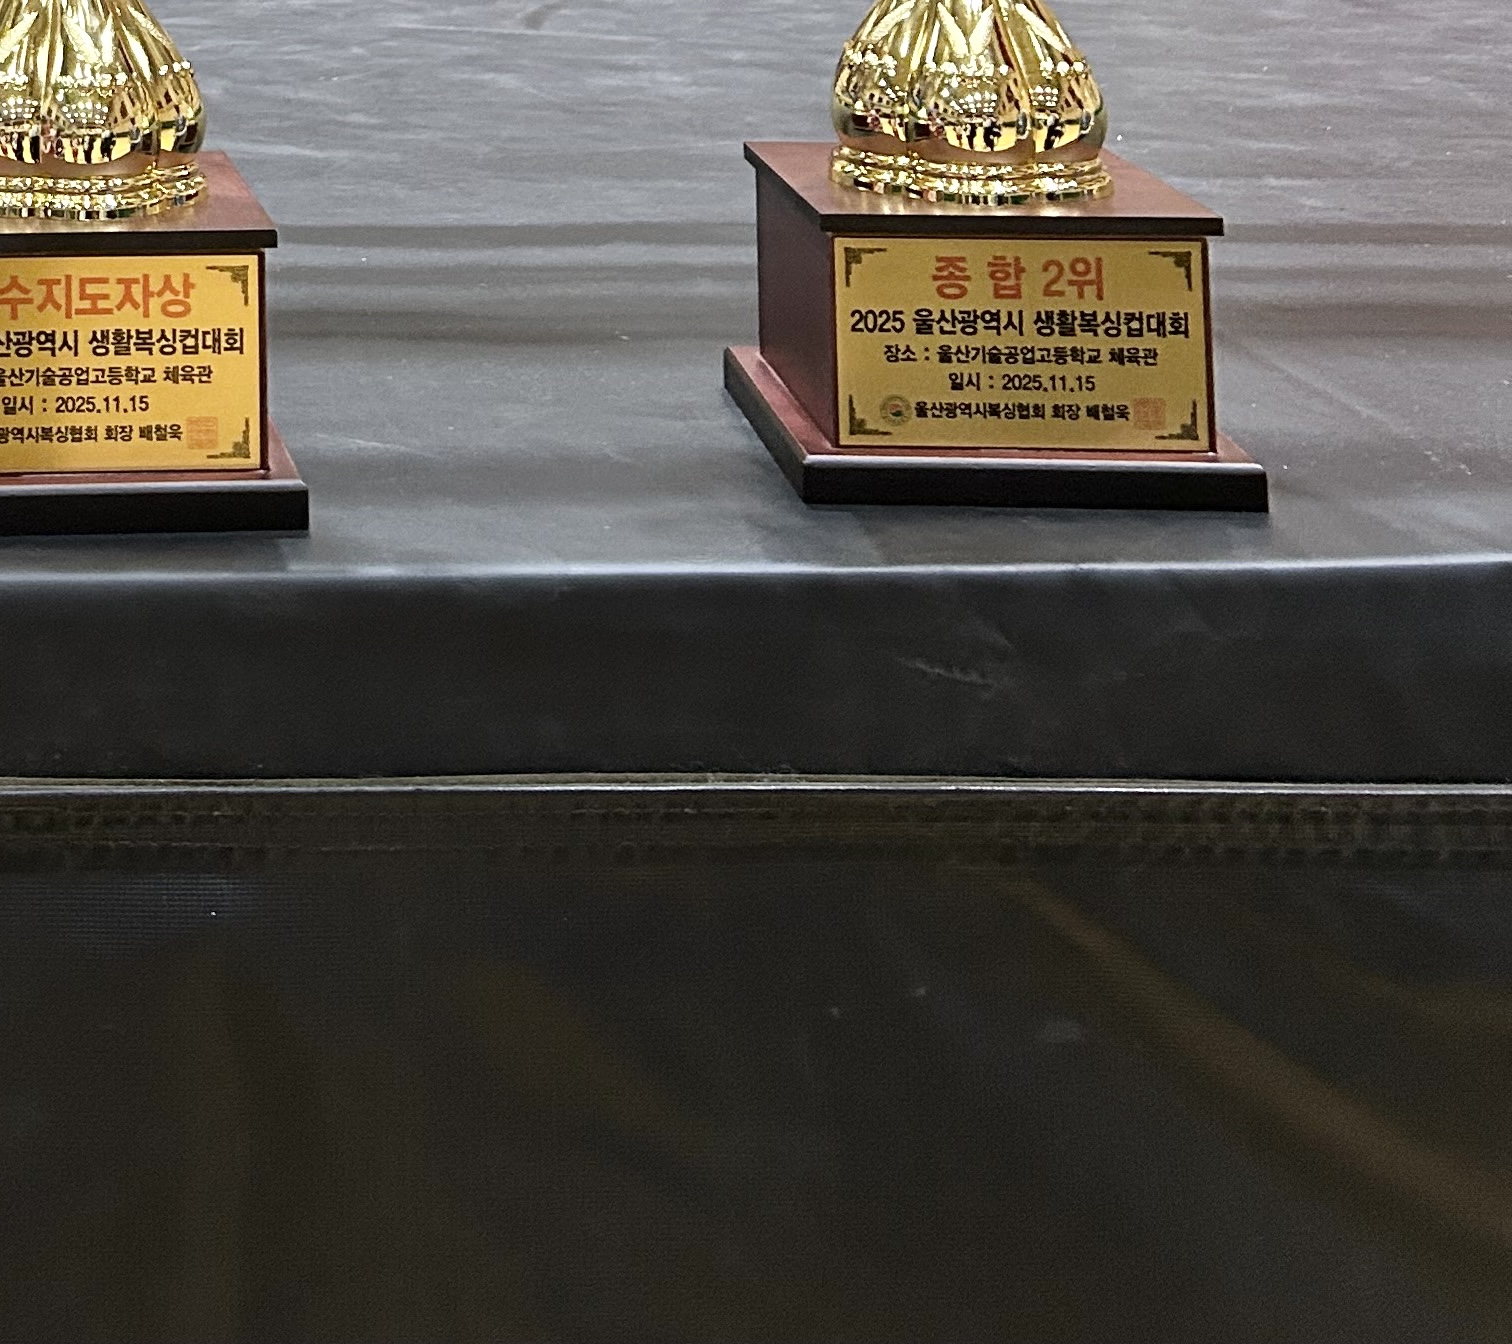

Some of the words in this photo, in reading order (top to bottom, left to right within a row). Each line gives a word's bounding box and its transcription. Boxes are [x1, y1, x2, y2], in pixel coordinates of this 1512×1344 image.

[851, 310, 905, 333] 2025
[913, 308, 1024, 336] 울산광역시
[1033, 310, 1189, 338] 생활복싱컵대회
[88, 328, 244, 356] 생활복싱컵대회
[884, 344, 917, 363] 장소
[937, 345, 1102, 365] 울산기술공업고등학교
[1109, 347, 1158, 366] 체육관
[163, 365, 213, 384] 체육관
[949, 373, 980, 391] 일시
[1002, 374, 1095, 392] 2025.11.15
[2, 396, 33, 415] 일시
[56, 395, 149, 413] 2025.11.15
[1051, 404, 1081, 420] 회장
[104, 425, 133, 441] 회장
